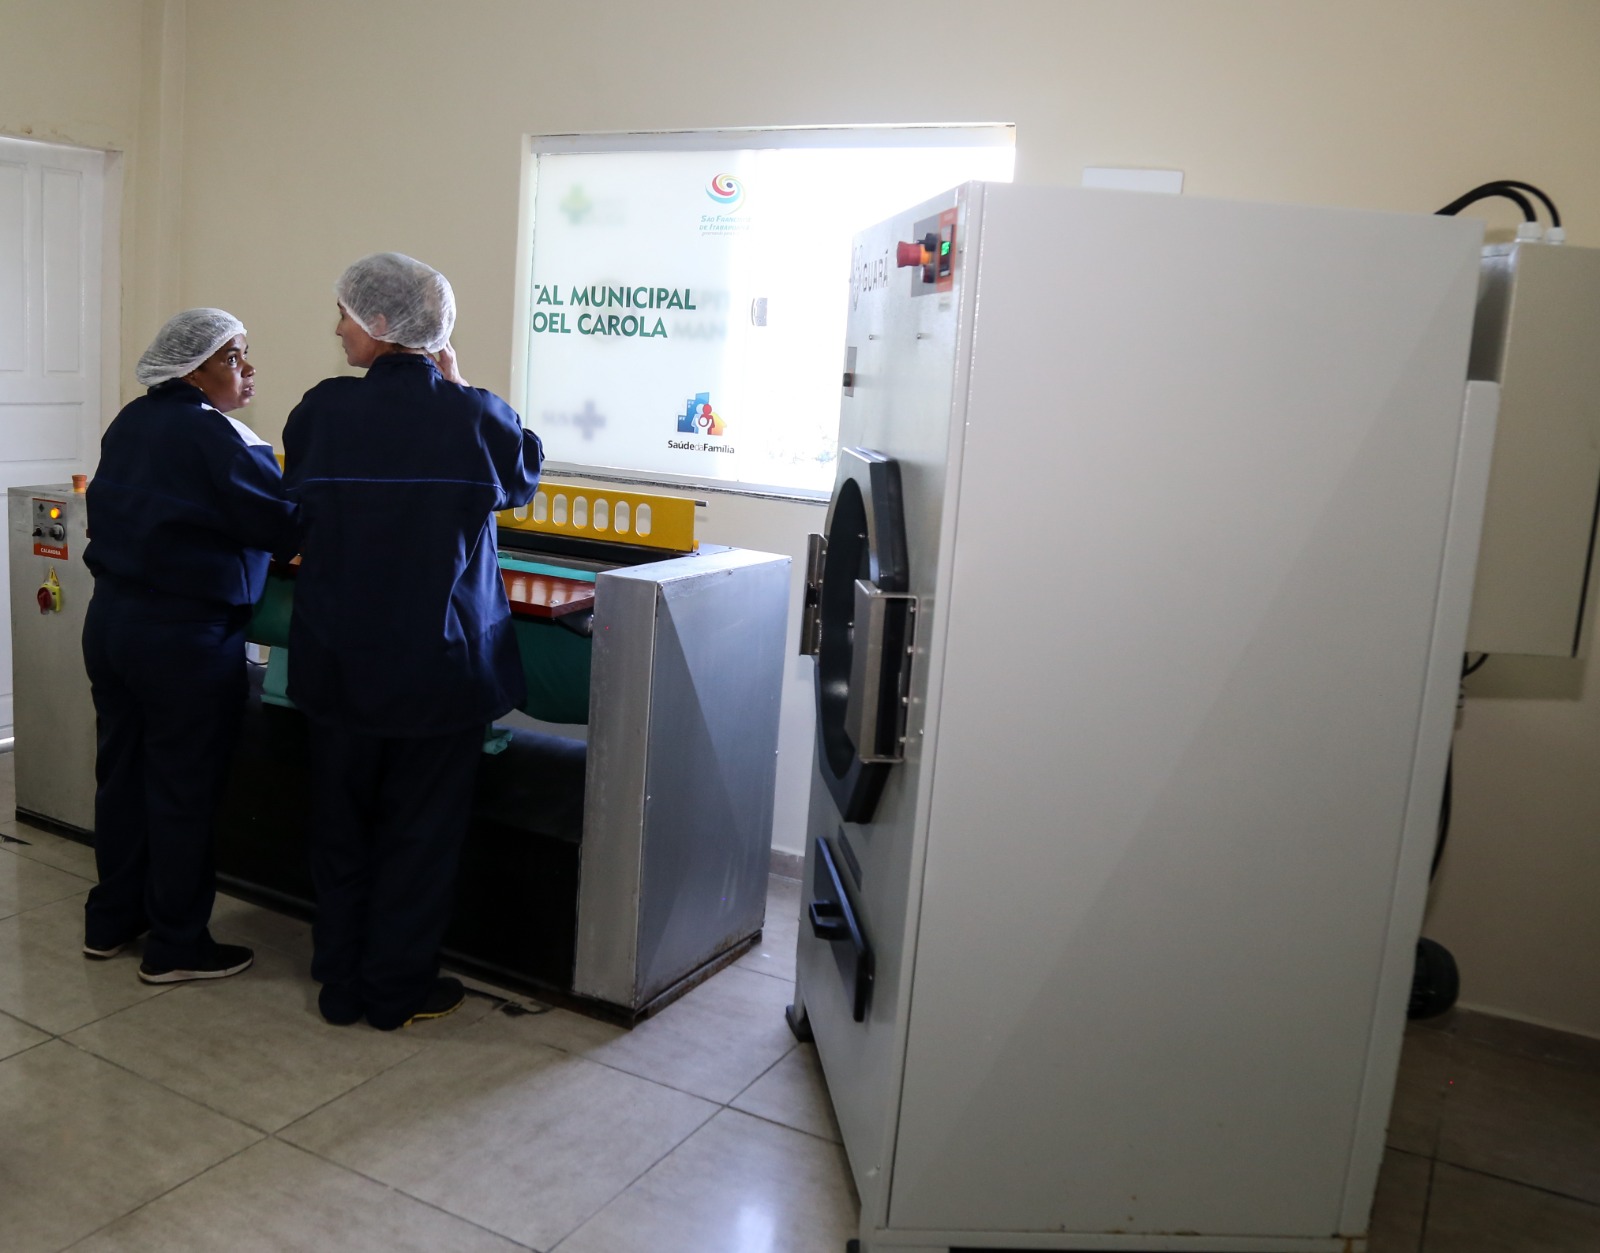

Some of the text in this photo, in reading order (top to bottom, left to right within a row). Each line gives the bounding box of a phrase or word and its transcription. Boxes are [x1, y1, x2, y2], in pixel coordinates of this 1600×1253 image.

[863, 248, 888, 292] GUARÁ
[569, 285, 697, 310] MUNICIPAL
[577, 313, 668, 338] CAROLA
